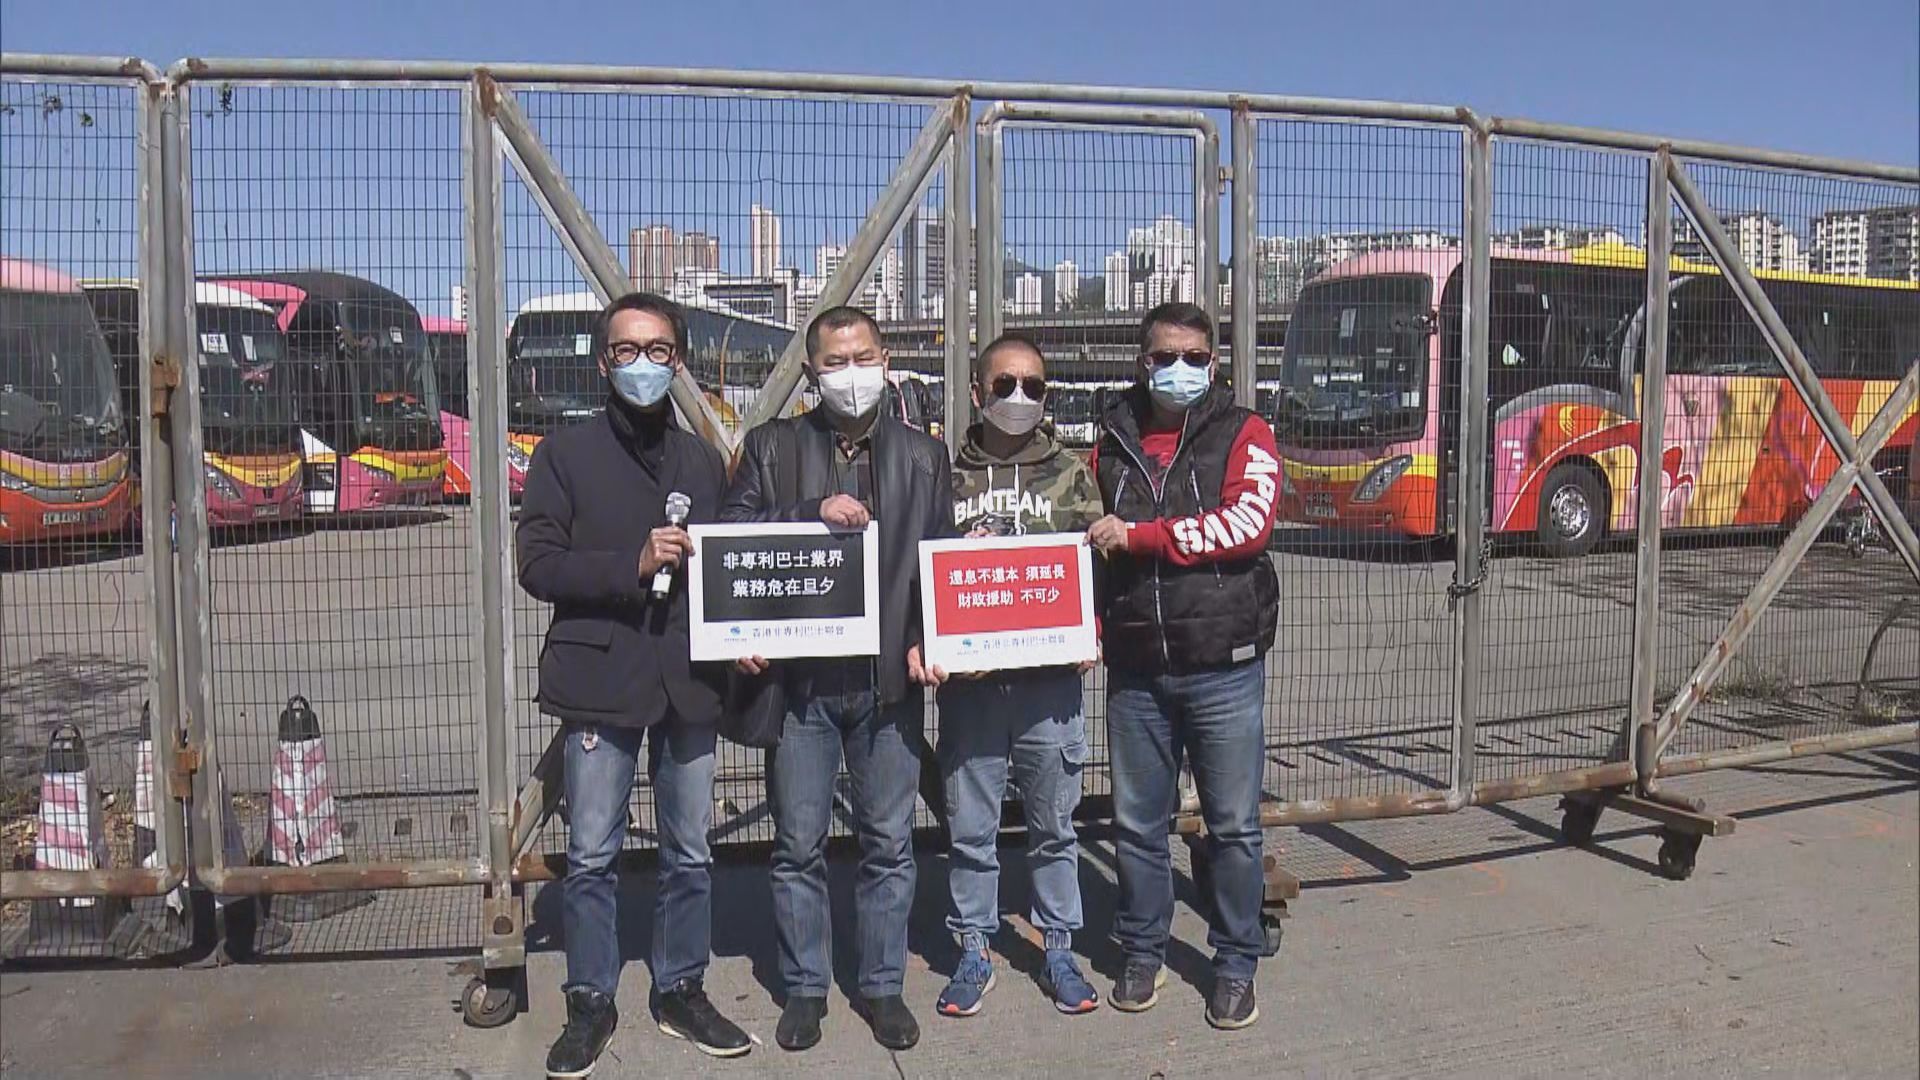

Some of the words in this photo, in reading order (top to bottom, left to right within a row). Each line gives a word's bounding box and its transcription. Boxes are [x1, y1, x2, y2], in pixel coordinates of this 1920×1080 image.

[954, 488, 1052, 528] BLKTEAM
[722, 549, 845, 571] 非專利巴士業界
[1025, 563, 1066, 582] 須延長
[732, 576, 835, 598] 業務危在旦夕
[957, 589, 1014, 609] 財政援助
[1020, 585, 1061, 605] 不可少
